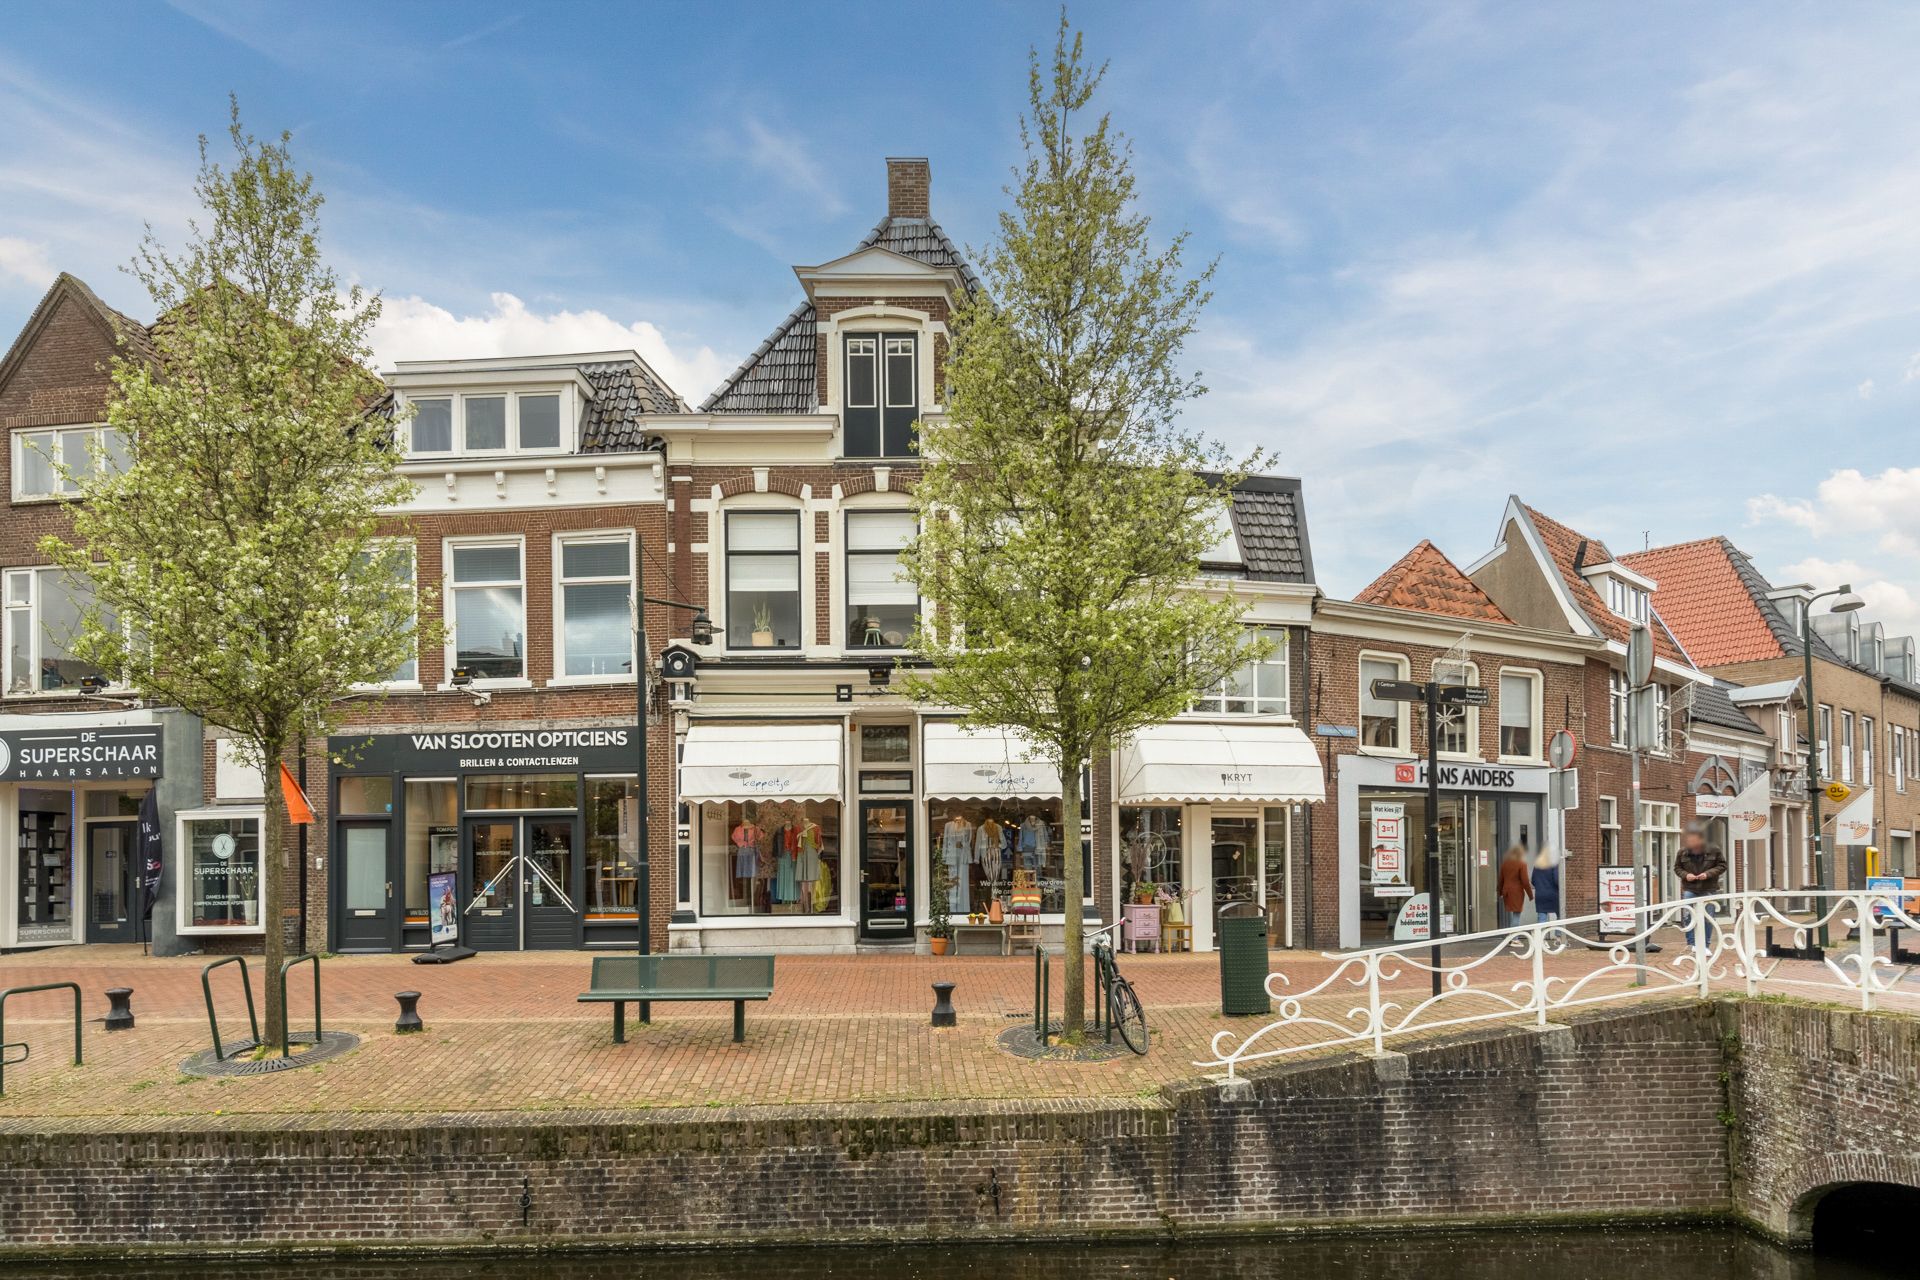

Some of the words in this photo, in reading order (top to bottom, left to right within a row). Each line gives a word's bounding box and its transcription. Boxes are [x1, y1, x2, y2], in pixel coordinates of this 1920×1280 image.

[81, 732, 96, 742] DE
[412, 735, 446, 750] VAN
[451, 733, 534, 749] SLOOTEN
[537, 731, 628, 747] OPTICIENS
[20, 745, 157, 764] SUPERSCHAAR
[460, 758, 496, 768] BRILLEN
[498, 758, 504, 767] &
[506, 757, 579, 767] CONTACTLENZEN
[20, 766, 157, 778] HAARSALON
[1227, 773, 1253, 781] KRYT
[1420, 766, 1458, 785] HNS
[1461, 768, 1515, 787] ANDERS
[194, 867, 253, 875] SUPERSCHAAR
[1412, 926, 1428, 934] gratis
